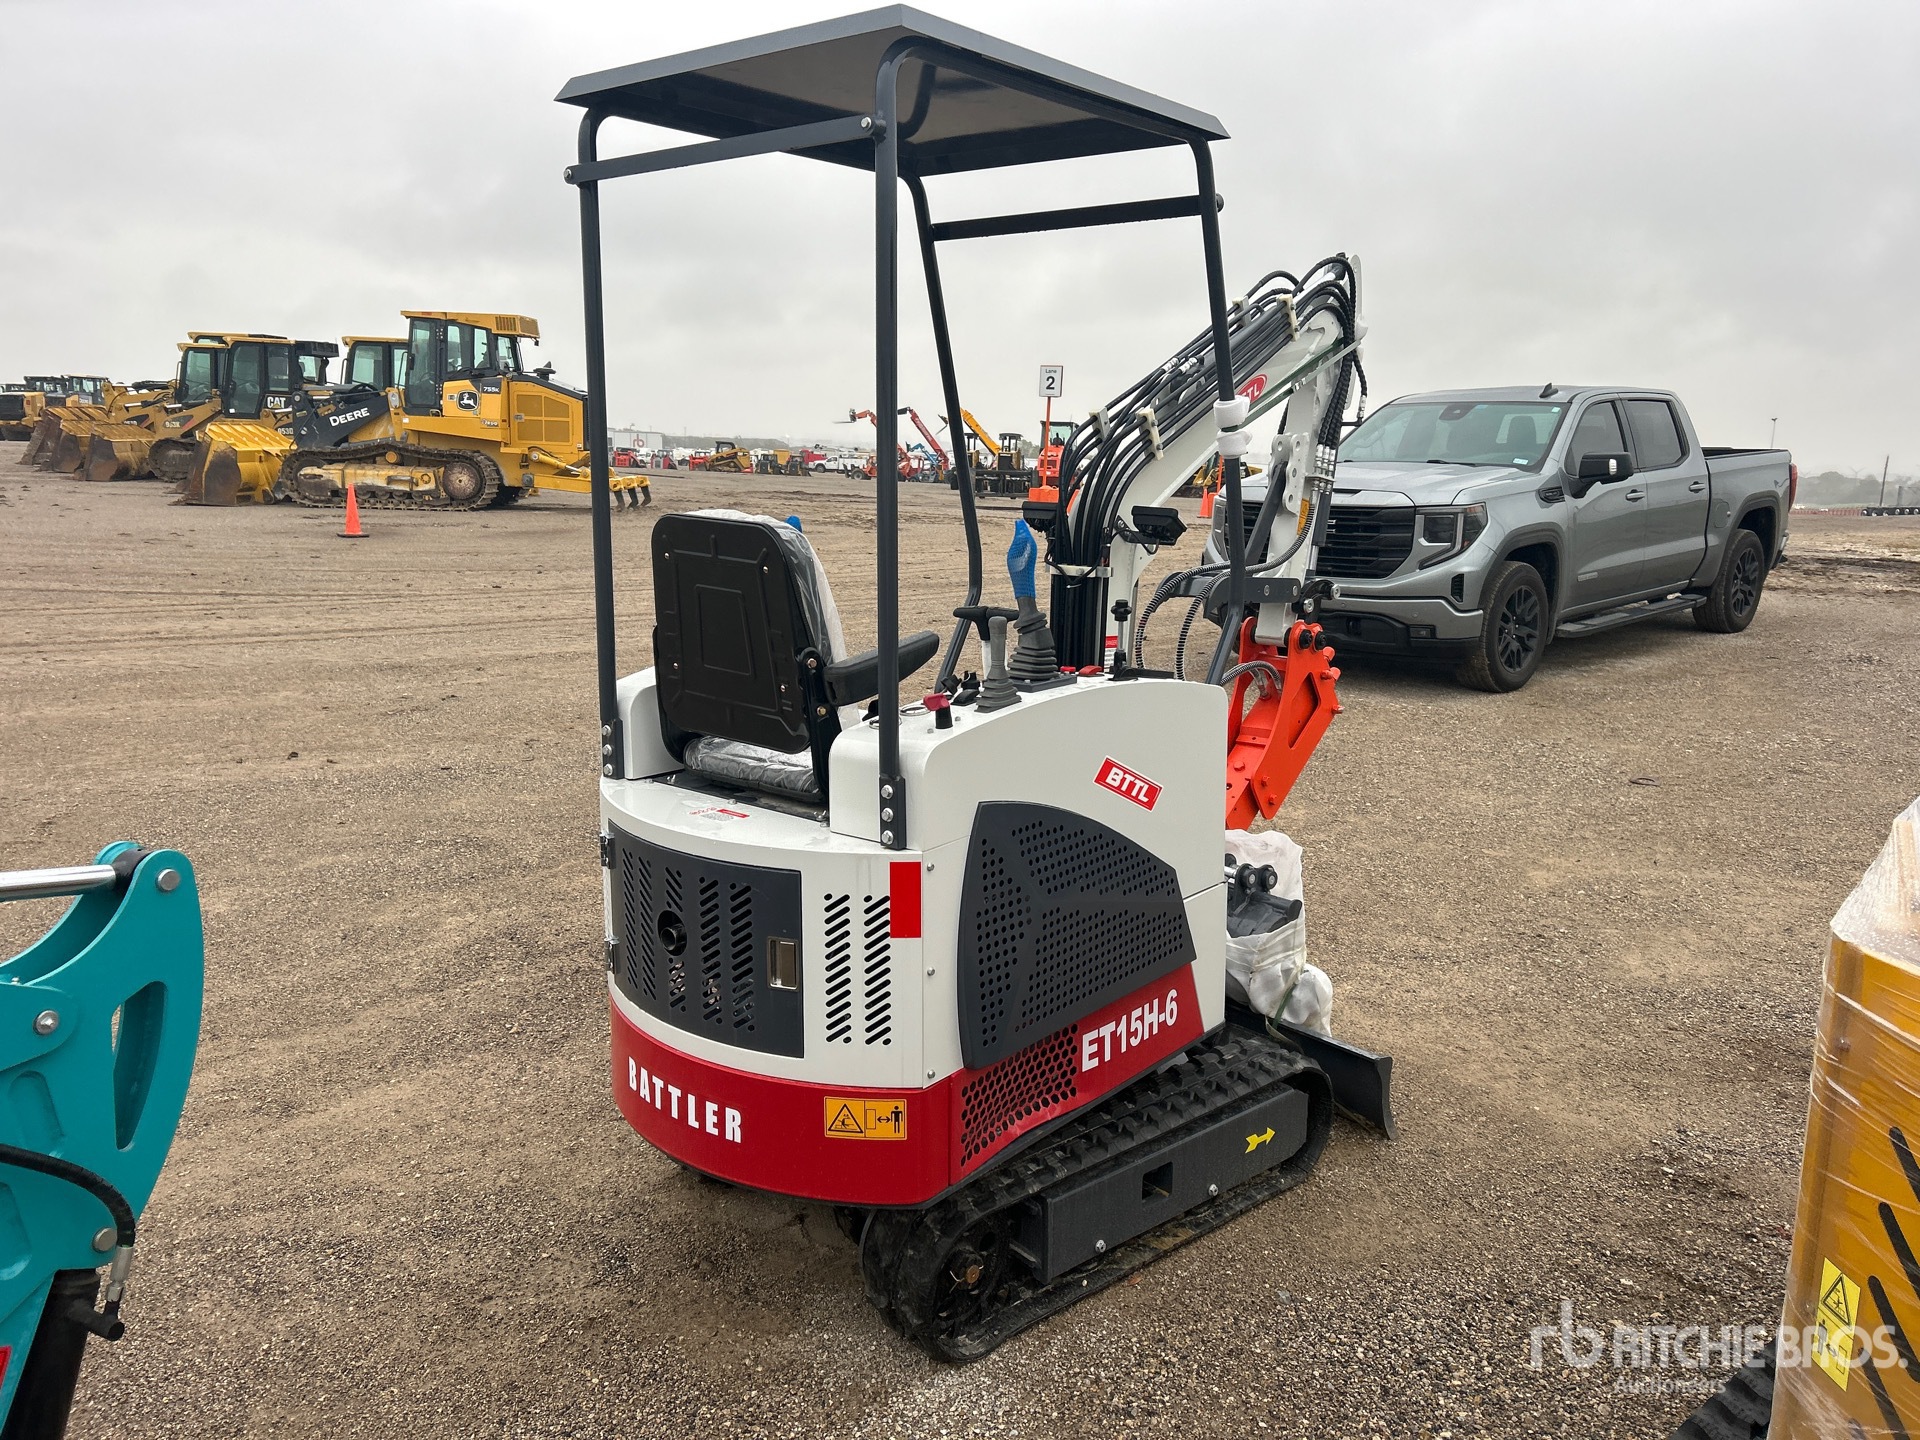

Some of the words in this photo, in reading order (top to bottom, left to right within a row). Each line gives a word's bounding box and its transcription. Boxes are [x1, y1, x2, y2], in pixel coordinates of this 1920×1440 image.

[1045, 375, 1055, 390] 2
[266, 396, 286, 409] CAT
[329, 407, 370, 427] DEERE
[1105, 766, 1149, 803] BTTL
[1082, 988, 1178, 1073] ET15H-6
[628, 1055, 742, 1144] BATTLER
